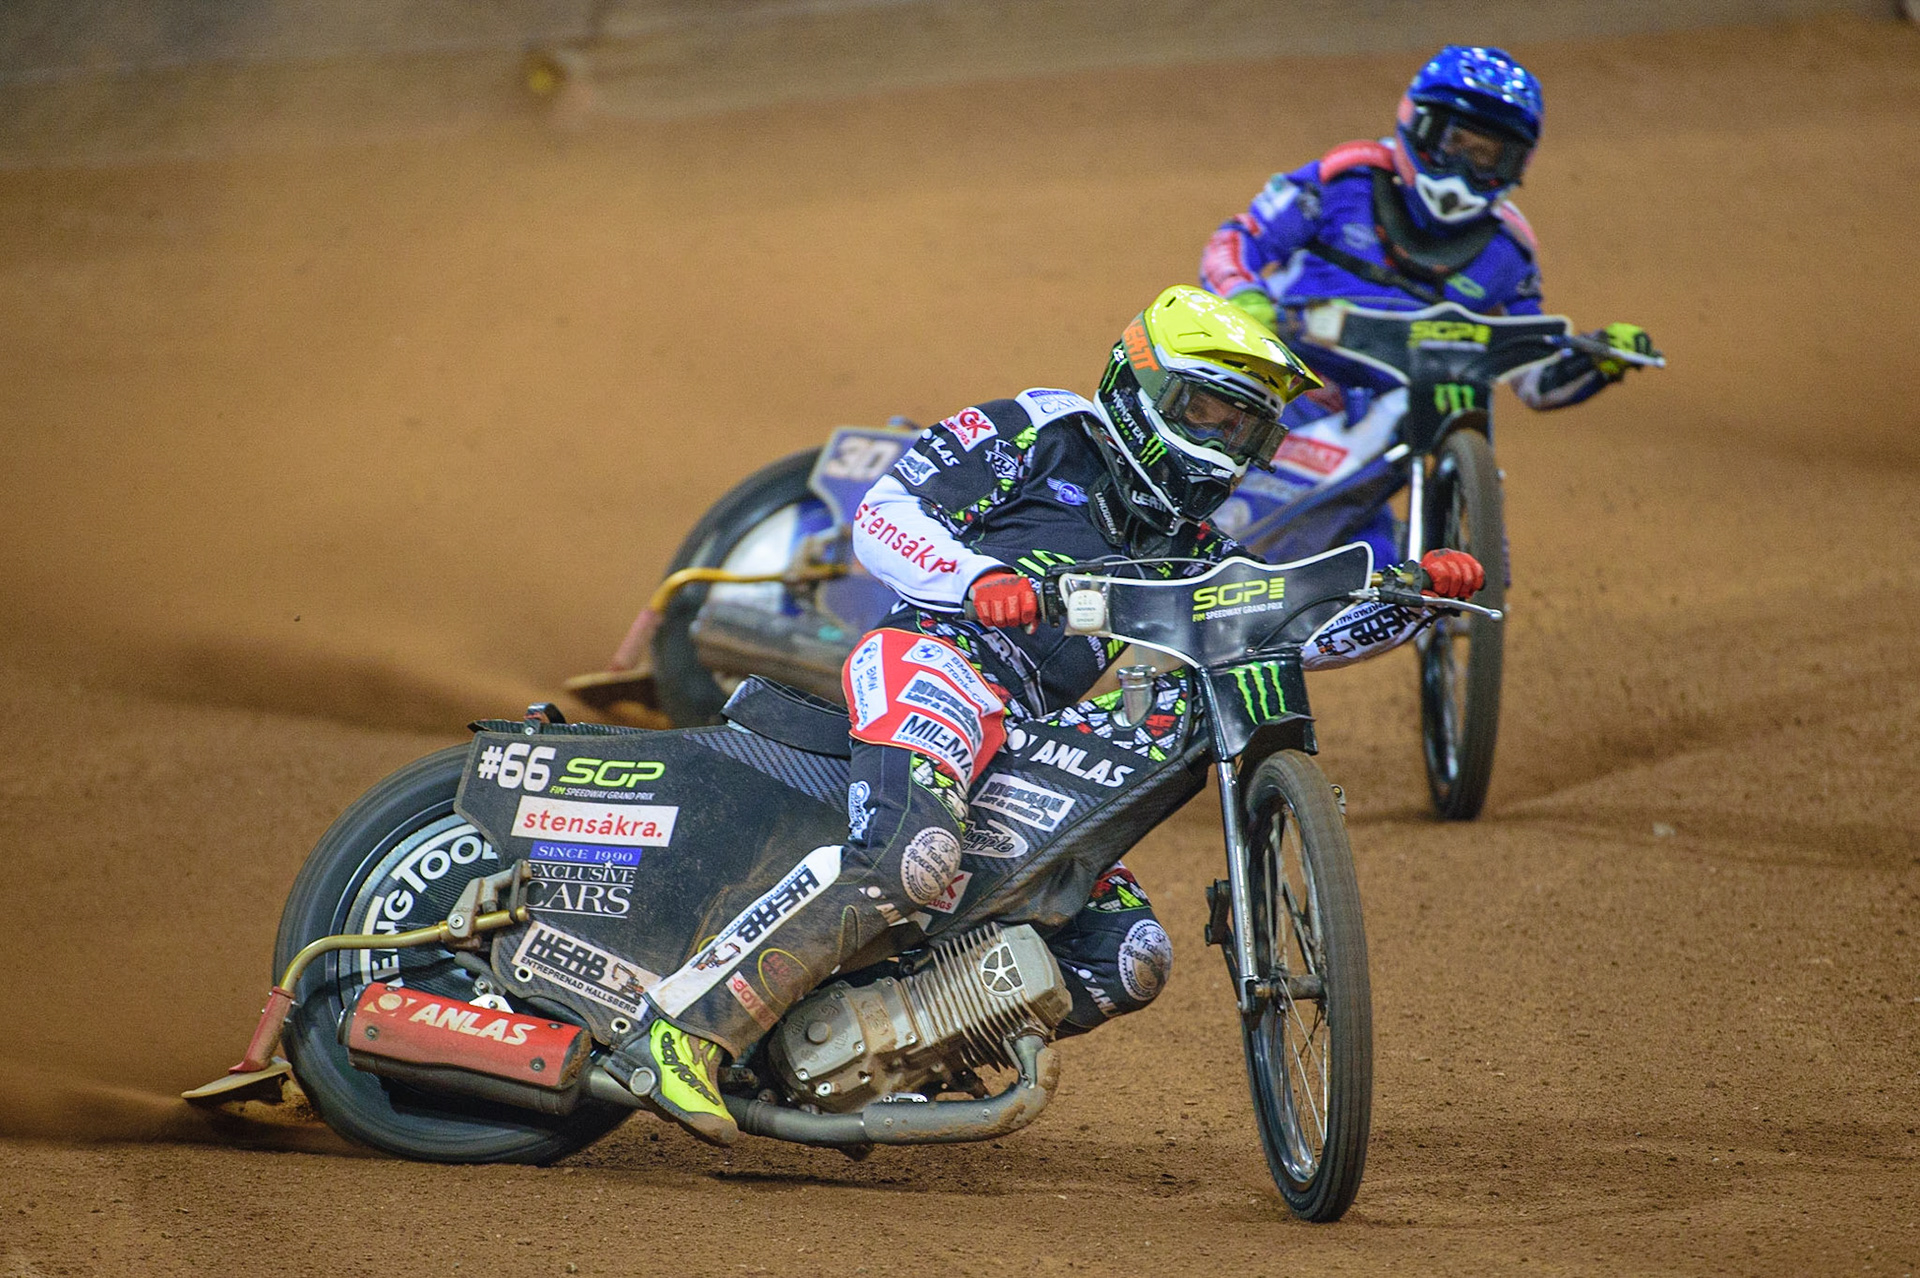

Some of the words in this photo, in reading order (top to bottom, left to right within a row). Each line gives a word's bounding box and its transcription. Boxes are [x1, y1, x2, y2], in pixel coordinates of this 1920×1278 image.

[1112, 389, 1146, 445] MONSTER
[1094, 492, 1118, 535] LINDGREN
[1205, 607, 1242, 620] SPEEDWAY
[1242, 603, 1267, 614] GRAND
[1267, 601, 1284, 611] PRIX
[951, 656, 976, 684] BMW
[896, 734, 935, 751] SWEDEN
[477, 742, 556, 792] #66
[558, 757, 666, 788] SGP
[1030, 740, 1135, 787] ANLAS
[549, 785, 565, 795] FIM
[565, 787, 608, 799] SPEEDWAY
[607, 790, 636, 800] GRAND
[635, 792, 655, 801] PRIX
[538, 845, 588, 860] SINCE
[594, 850, 633, 862] 1990
[531, 863, 636, 884] EXCLUSIVE
[525, 880, 631, 915] CARS
[521, 956, 584, 991] ENTREPRENAD
[585, 986, 637, 1014] HALLSBERG
[409, 1003, 537, 1046] ANLAS
